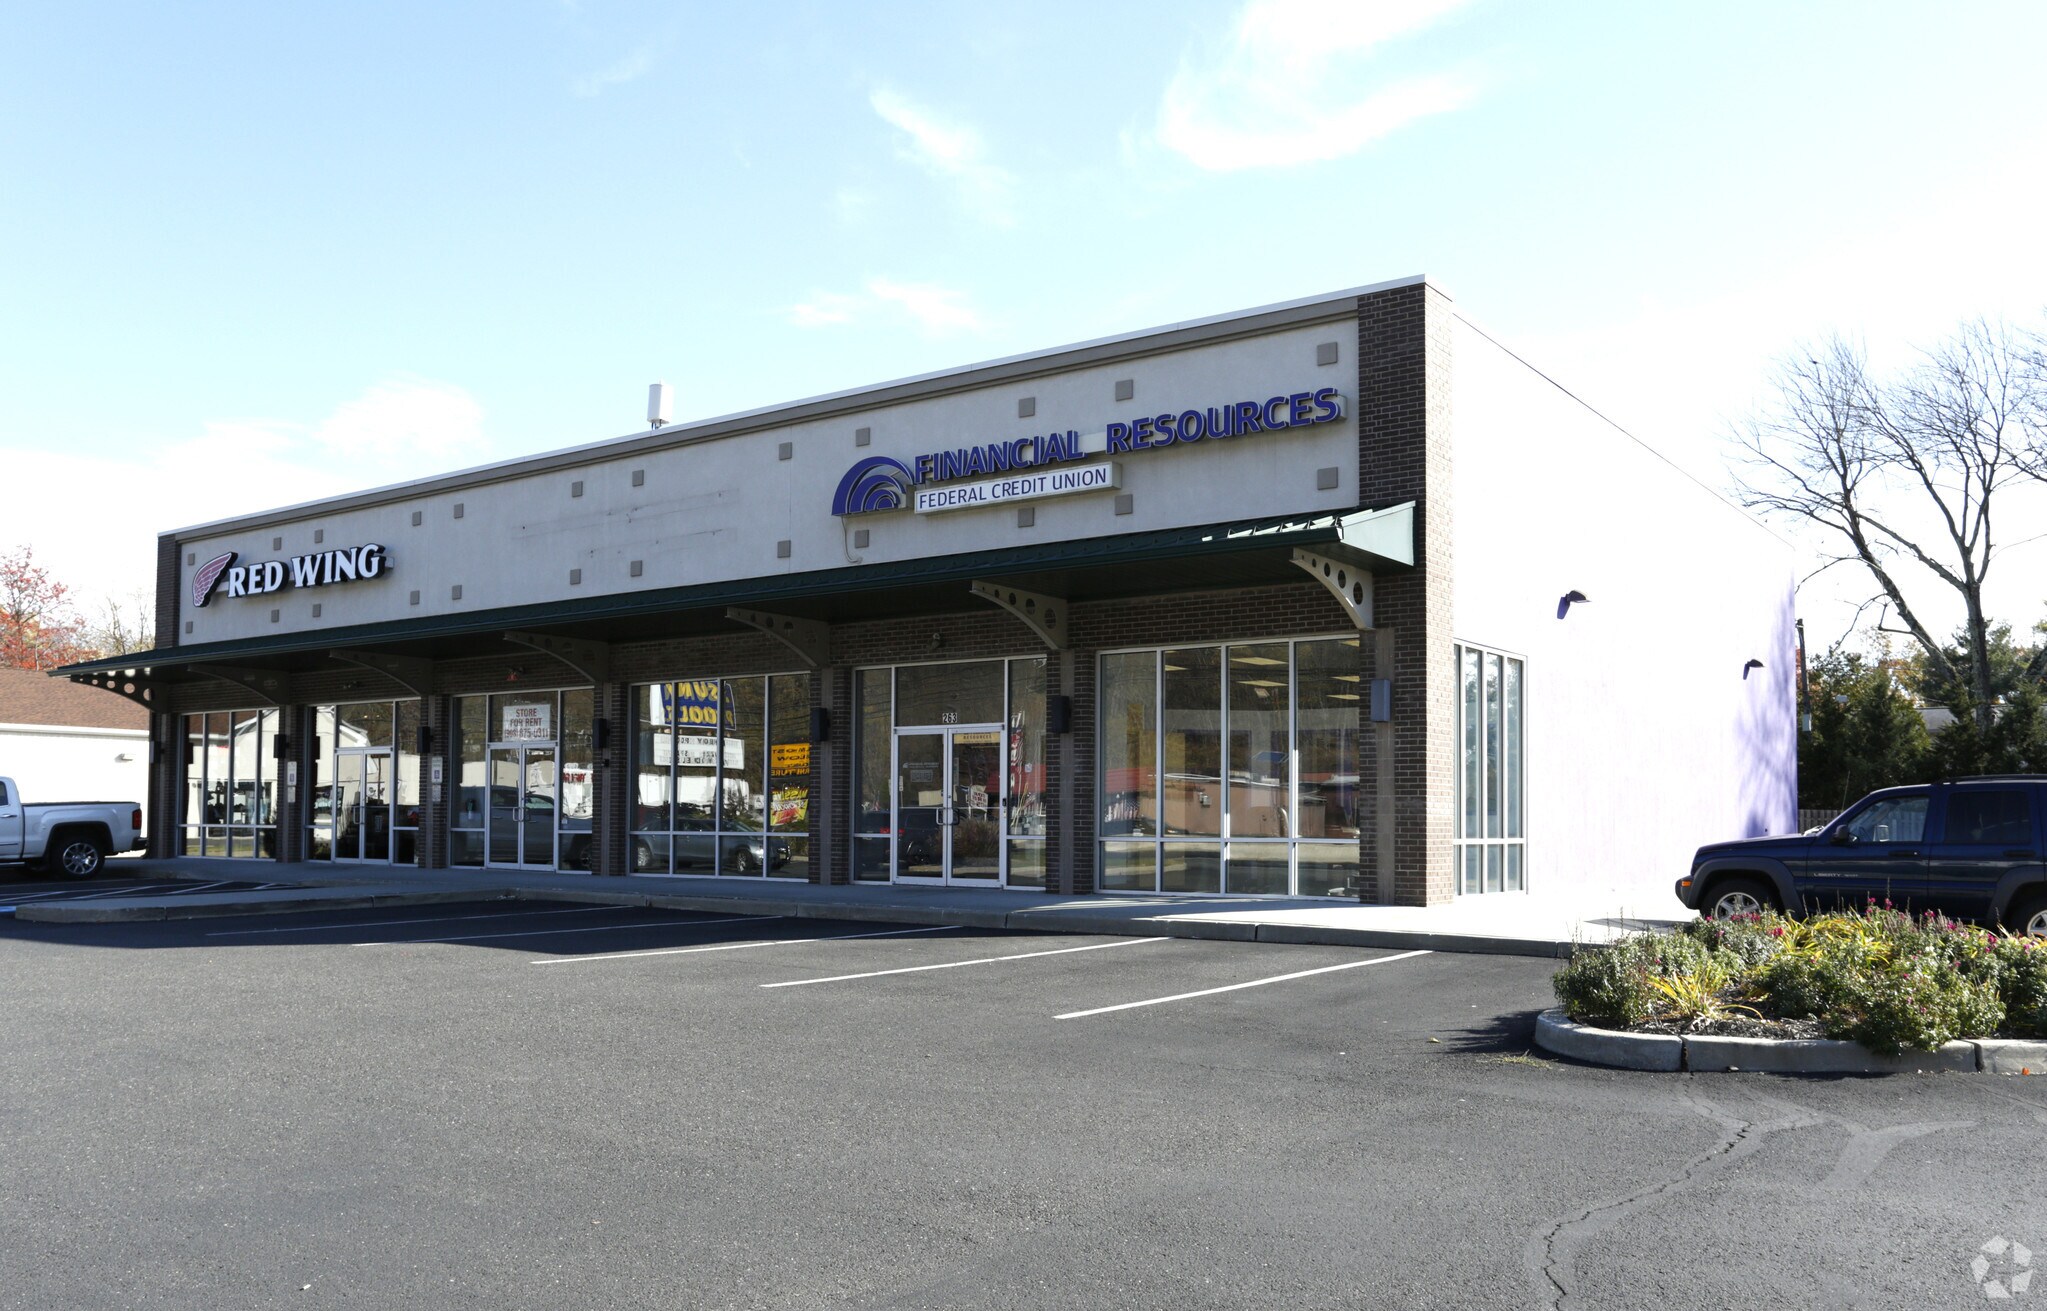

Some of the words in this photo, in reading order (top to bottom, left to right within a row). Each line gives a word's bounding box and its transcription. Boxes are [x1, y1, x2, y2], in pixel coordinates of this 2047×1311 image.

[914, 430, 1087, 484] FINANCIAL
[1105, 388, 1341, 455] RESOURCES
[919, 488, 987, 509] FEDERAL
[991, 476, 1047, 499] CREDIT
[1052, 468, 1106, 490] UNION
[227, 560, 286, 598] RED
[291, 543, 383, 588] WING
[510, 718, 524, 727] FOR
[525, 717, 543, 727] RENT
[516, 708, 537, 718] STORE
[943, 713, 957, 723] 263
